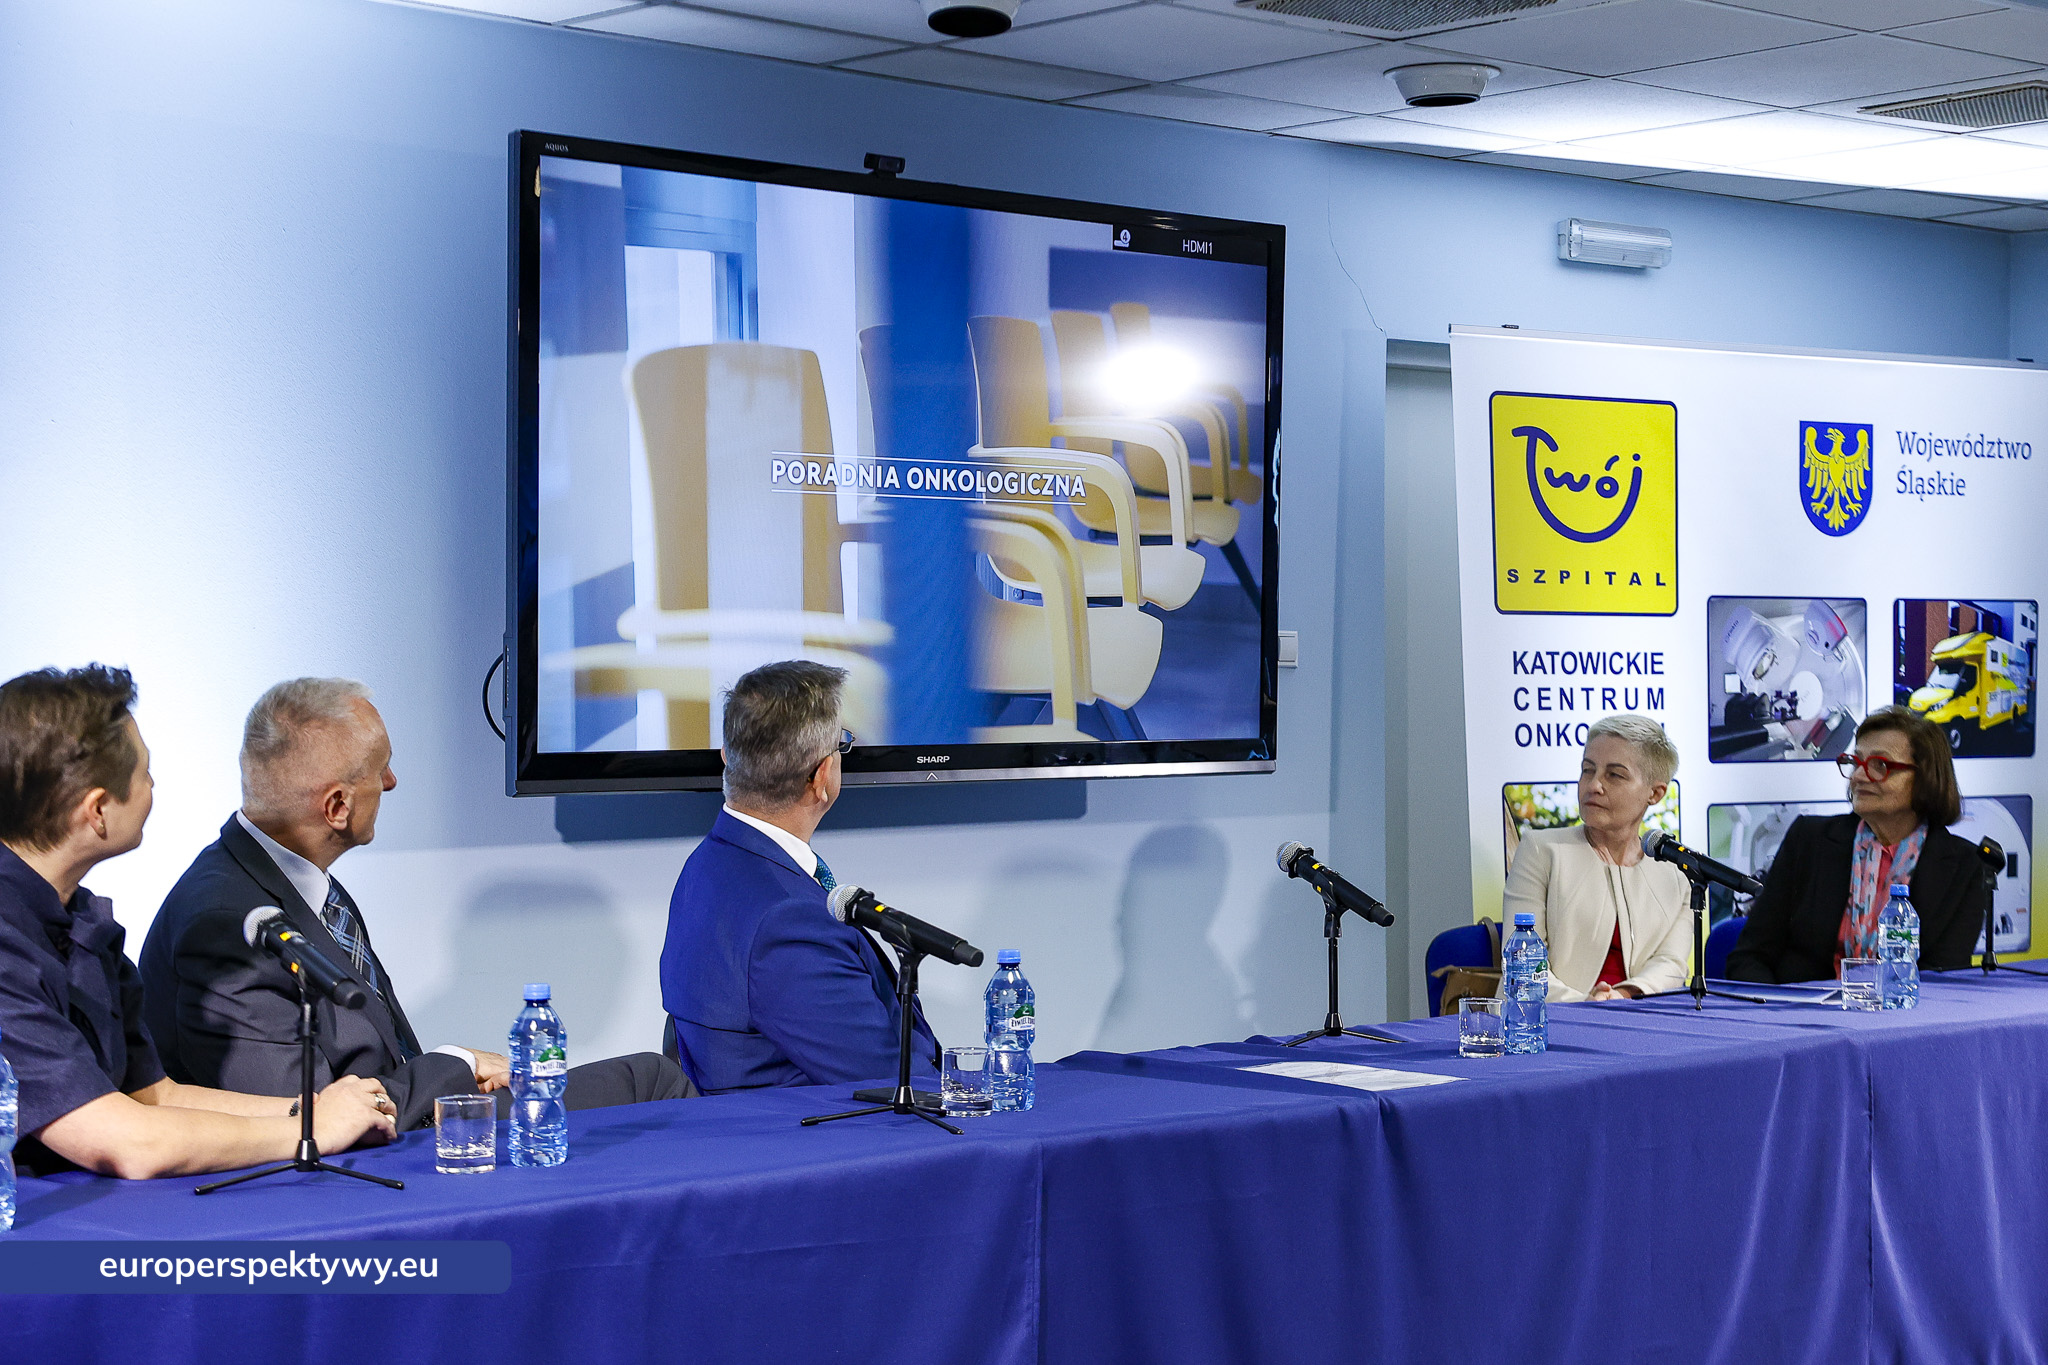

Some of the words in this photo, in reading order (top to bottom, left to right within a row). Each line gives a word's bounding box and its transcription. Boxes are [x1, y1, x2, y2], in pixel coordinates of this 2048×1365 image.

[544, 142, 569, 152] AQUOS
[1182, 239, 1213, 255] HDMI1
[1895, 430, 2032, 462] Województwo
[771, 459, 900, 490] PORADNIA
[906, 466, 1086, 497] ONKOLOGICZNA
[1511, 426, 1643, 543] Twój
[1896, 464, 1966, 502] Śląskie
[1506, 568, 1667, 586] SZPITAL
[1512, 651, 1665, 675] KATOWICKIE
[1513, 687, 1665, 711] CENTRUM
[916, 755, 950, 764] SHARP
